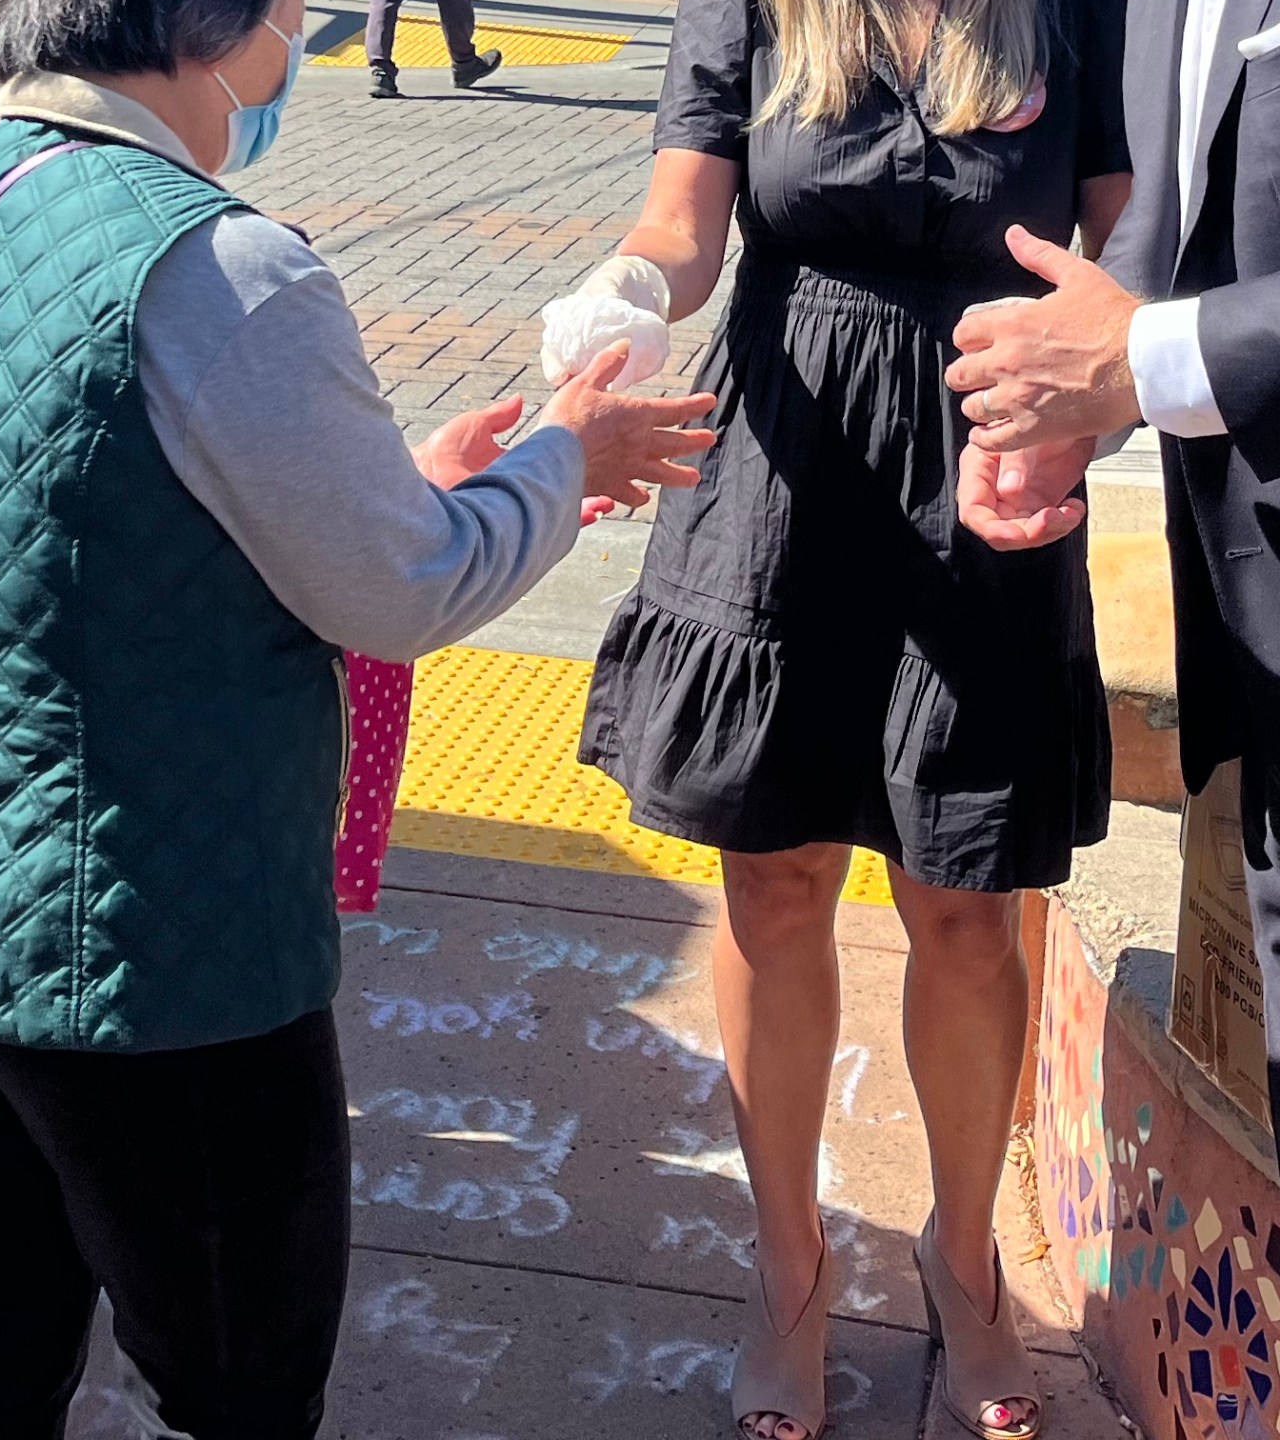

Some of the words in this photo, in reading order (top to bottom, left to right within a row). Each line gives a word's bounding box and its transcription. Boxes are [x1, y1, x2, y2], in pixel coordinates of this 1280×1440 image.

[1188, 895, 1246, 959] MICROWAVE
[1215, 974, 1231, 999] 200
[1233, 990, 1266, 1028] PCS/C
